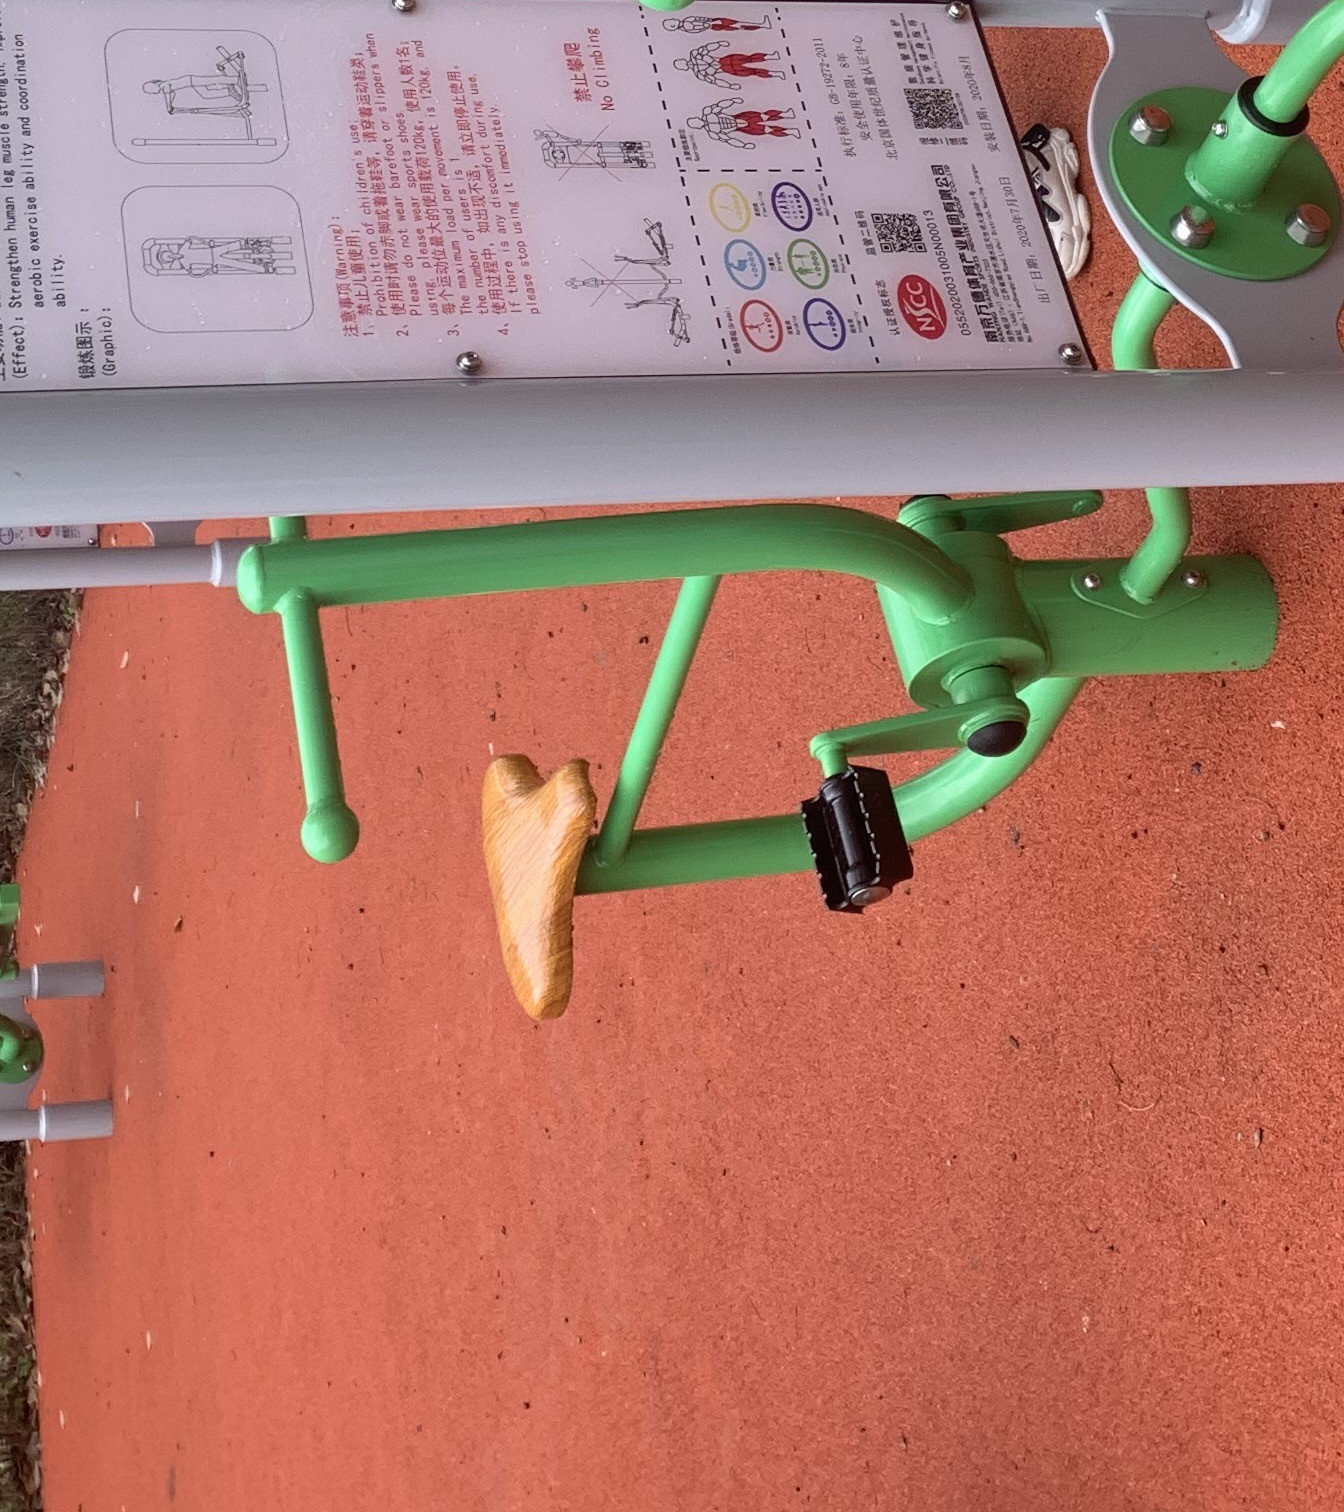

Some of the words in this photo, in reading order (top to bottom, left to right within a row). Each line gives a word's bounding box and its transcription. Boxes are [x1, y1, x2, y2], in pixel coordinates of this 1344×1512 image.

[365, 33, 377, 58] when
[412, 40, 425, 57] and
[587, 28, 610, 88] Climbing
[13, 34, 29, 110] coordination
[372, 64, 387, 112] slippers
[564, 42, 592, 102] 禁止攀爬
[426, 106, 436, 117] is
[473, 100, 488, 138] during
[601, 95, 615, 111] No
[18, 116, 32, 136] and
[380, 119, 390, 130] or
[20, 143, 35, 190] ability
[383, 138, 401, 188] barefoot
[429, 125, 447, 176] movement
[0, 169, 15, 188] leg
[352, 150, 371, 214] children's
[402, 150, 417, 188] sports
[455, 169, 464, 180] is
[482, 144, 502, 208] discomfort
[441, 183, 453, 202] per
[503, 183, 514, 193] it
[3, 197, 16, 231] human
[393, 196, 406, 221] wear
[410, 196, 422, 221] wear
[443, 208, 457, 232] load
[457, 189, 471, 221] users
[508, 201, 523, 234] using
[25, 197, 40, 251] exercise
[364, 223, 375, 234] of
[398, 229, 410, 248] not
[465, 228, 475, 241] of
[495, 214, 507, 234] any
[402, 255, 413, 268] do
[416, 228, 432, 268] please
[500, 241, 510, 252] is
[516, 240, 529, 266] stop
[931, 164, 999, 343] 南京万德体育产业集团有限公司
[6, 237, 22, 308] Strengthen
[368, 242, 388, 316] Prohibition
[451, 240, 466, 288] maximum
[470, 249, 483, 288] number
[504, 261, 518, 294] there
[29, 258, 44, 307] aerobic
[52, 255, 67, 307] ability.
[408, 275, 422, 316] Please
[523, 274, 541, 314] please
[460, 295, 473, 314] The
[478, 295, 489, 315] the
[510, 301, 522, 312] If
[875, 279, 901, 336] 认证授权标志
[903, 282, 938, 331] NSCC
